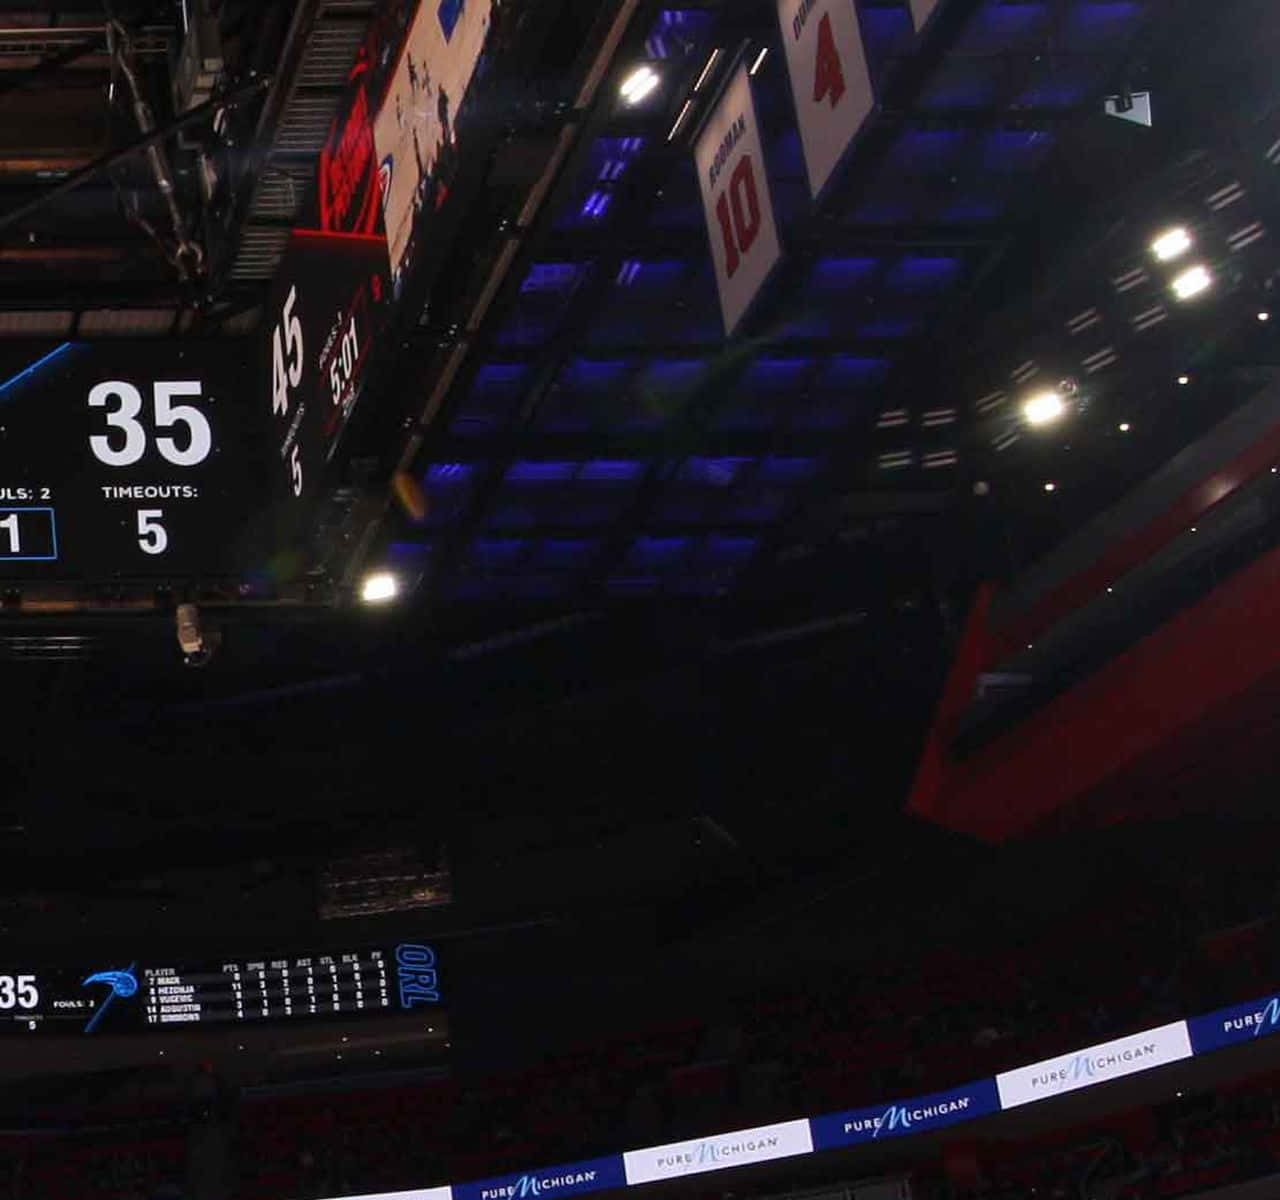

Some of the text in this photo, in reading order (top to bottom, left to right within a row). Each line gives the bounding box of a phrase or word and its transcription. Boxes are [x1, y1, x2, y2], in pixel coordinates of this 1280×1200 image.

[813, 11, 847, 110] 4
[716, 154, 761, 280] 10
[272, 285, 304, 417] 45
[330, 317, 359, 406] 5:01
[87, 380, 212, 467] 35
[40, 486, 52, 500] 2
[102, 484, 198, 499] TIMEOUTS:
[291, 444, 302, 496] 5
[136, 508, 167, 555] 5
[396, 944, 439, 1008] ORL
[1223, 1013, 1263, 1032] PURE
[1031, 1043, 1156, 1091] PURE MICHIGAN
[844, 1098, 970, 1138] PURE MICHIGAN
[657, 1137, 779, 1170] PURE MICHIGAN
[481, 1185, 515, 1200] PURE
